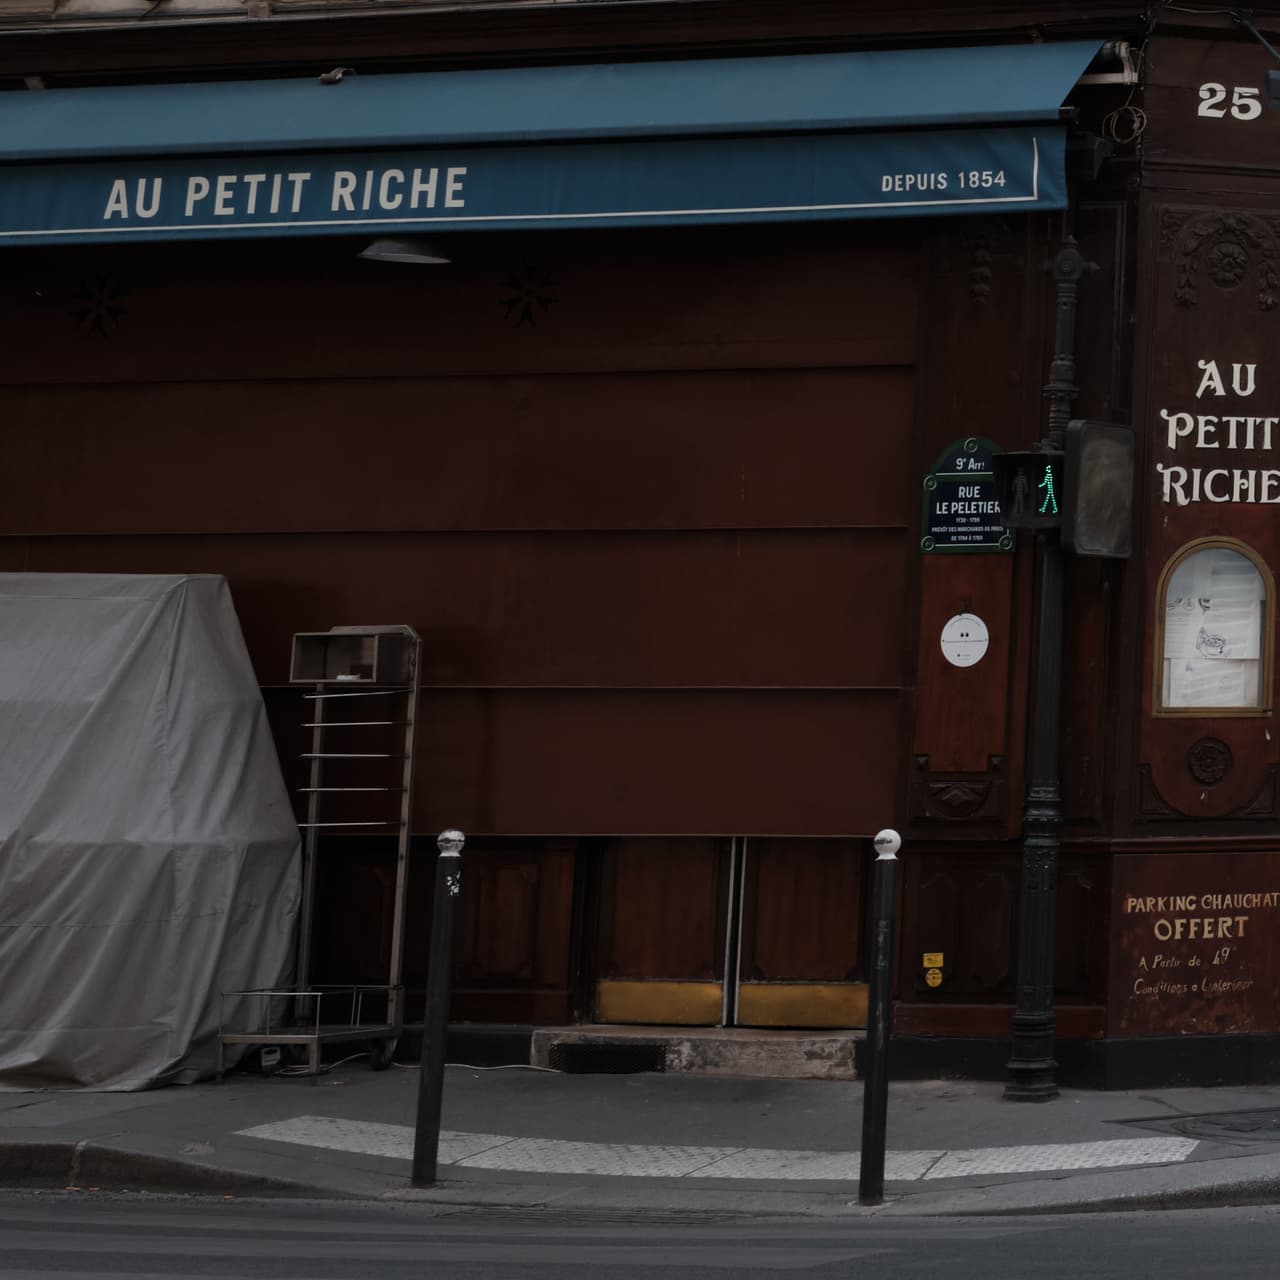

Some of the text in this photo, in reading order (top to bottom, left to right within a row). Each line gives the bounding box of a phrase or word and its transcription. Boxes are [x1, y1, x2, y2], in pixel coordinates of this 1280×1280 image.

[1197, 82, 1262, 121] 25
[881, 170, 1006, 192] DEPUIS 1854
[103, 166, 467, 220] AU PETIT RICHE
[1195, 359, 1257, 399] AU
[1160, 408, 1280, 450] PETIT
[958, 486, 981, 498] RUE
[936, 502, 949, 514] LE
[1127, 892, 1280, 913] PARKING CHAUCHAT
[1154, 916, 1249, 941] OFFERT
[1139, 956, 1149, 972] A
[1188, 955, 1200, 967] de
